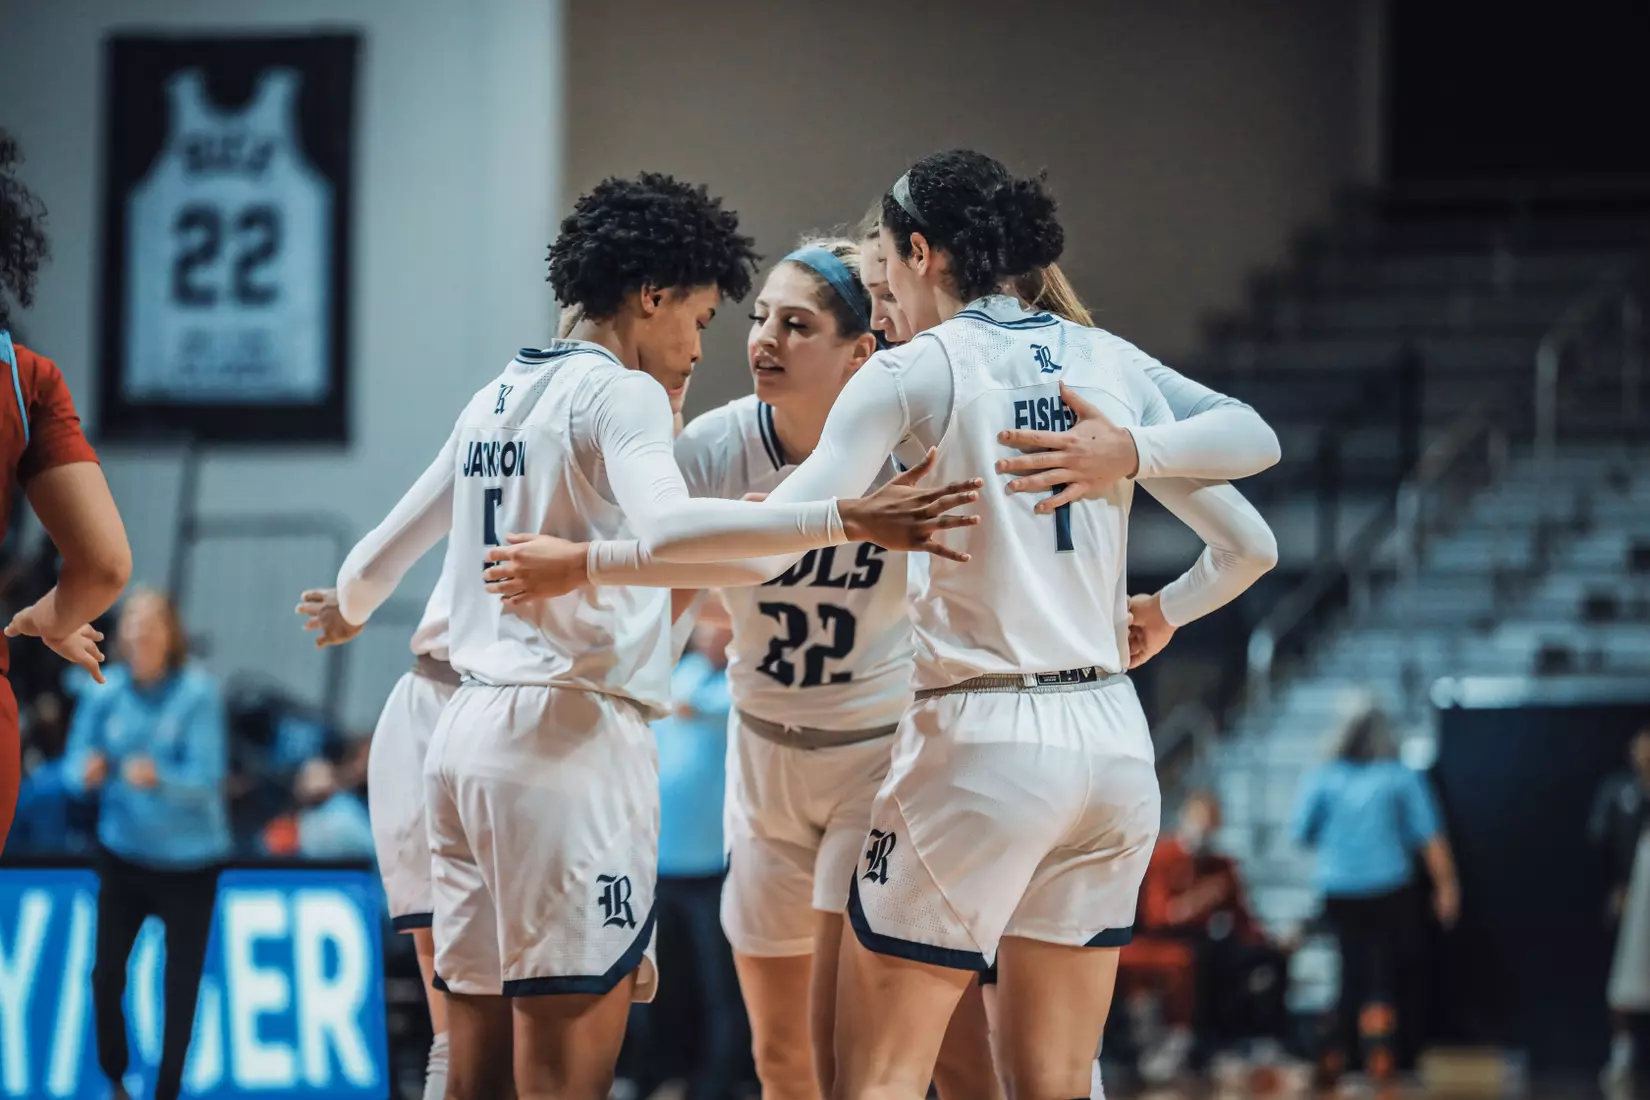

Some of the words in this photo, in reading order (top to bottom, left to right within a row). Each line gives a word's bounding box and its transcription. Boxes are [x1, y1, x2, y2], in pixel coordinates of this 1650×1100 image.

[170, 204, 284, 310] 22
[1030, 344, 1063, 373] R
[756, 601, 857, 688] 22
[862, 828, 897, 886] R
[596, 874, 637, 930] R
